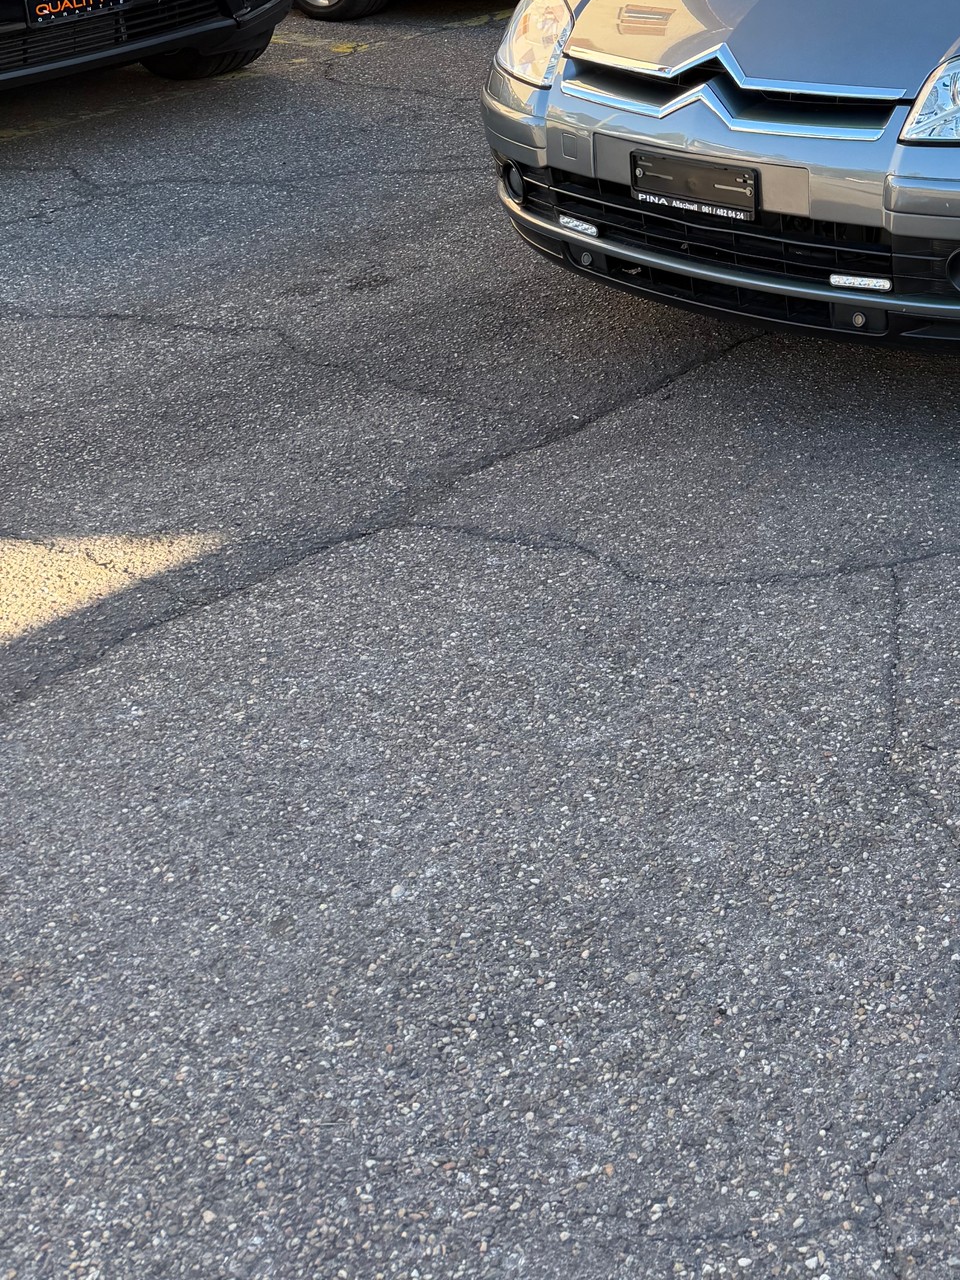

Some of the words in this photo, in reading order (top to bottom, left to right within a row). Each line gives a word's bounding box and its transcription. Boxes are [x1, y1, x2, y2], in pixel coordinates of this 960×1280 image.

[638, 193, 669, 206] PINA
[671, 200, 698, 212] Allschwil
[701, 205, 712, 214] 061
[716, 207, 727, 217] 482
[728, 208, 736, 219] 04
[736, 210, 744, 220] 24
